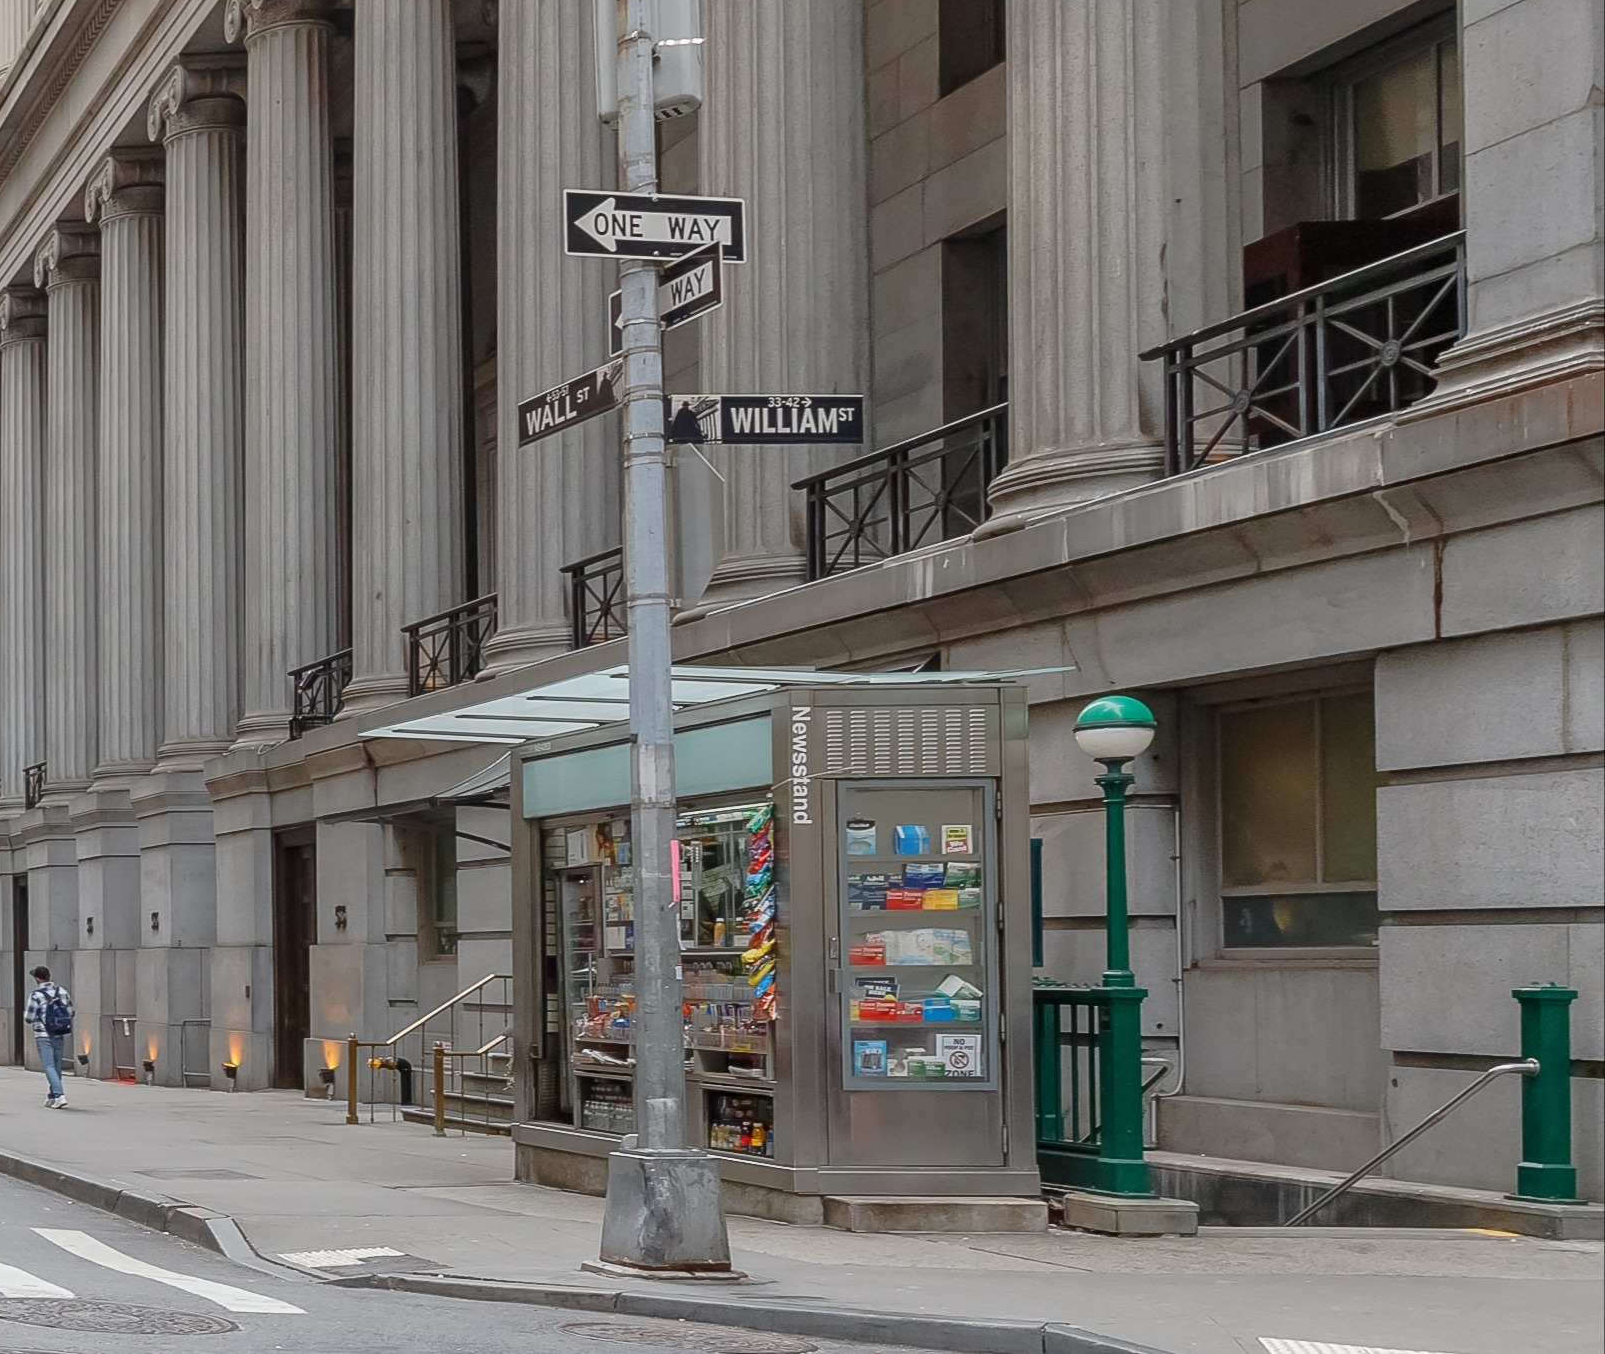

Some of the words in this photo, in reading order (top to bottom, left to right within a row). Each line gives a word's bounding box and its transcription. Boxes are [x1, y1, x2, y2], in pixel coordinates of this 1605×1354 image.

[593, 212, 644, 238] ONE
[667, 216, 720, 241] WAY
[670, 267, 706, 307] WAY
[526, 395, 578, 435] WALL
[576, 386, 590, 403] ST
[767, 397, 800, 408] 33-42
[730, 407, 838, 434] WILLIAM
[838, 407, 855, 421] ST
[792, 706, 813, 825] Newsstand
[953, 1038, 966, 1046] NO
